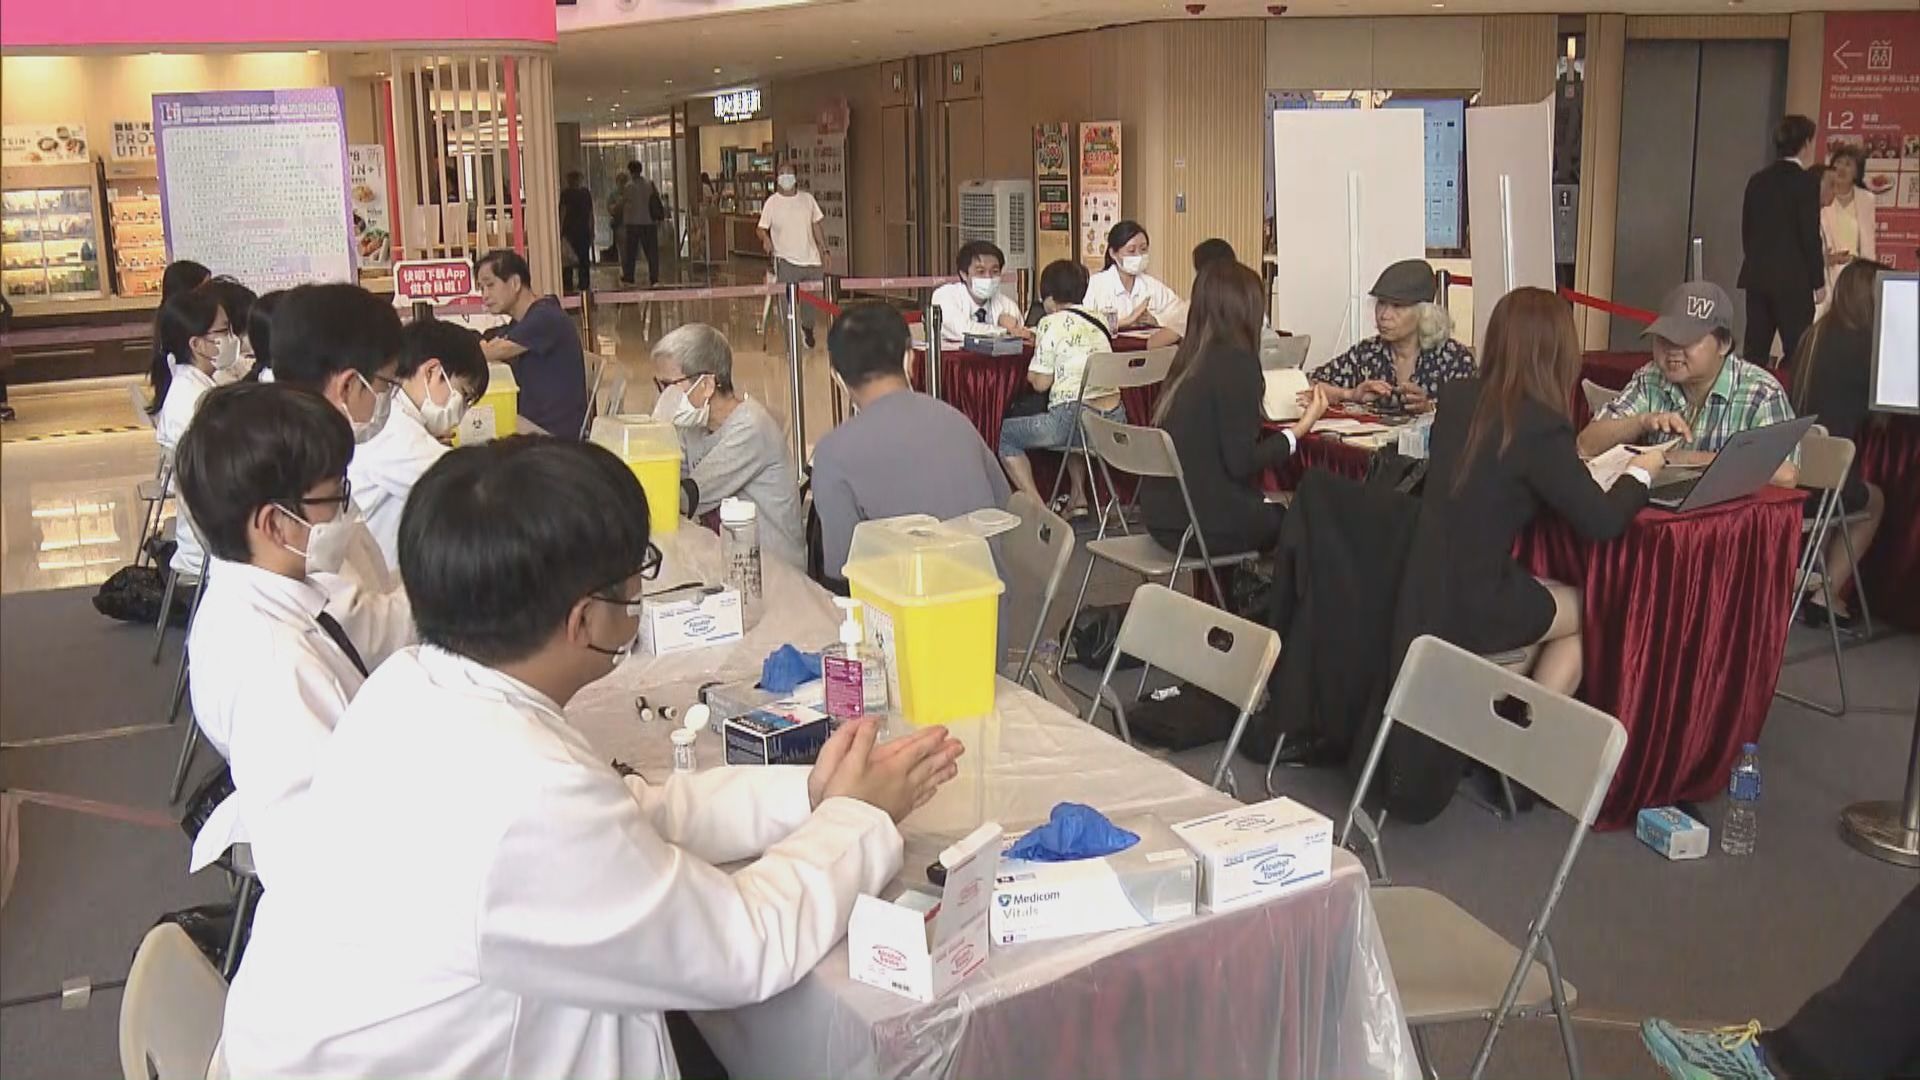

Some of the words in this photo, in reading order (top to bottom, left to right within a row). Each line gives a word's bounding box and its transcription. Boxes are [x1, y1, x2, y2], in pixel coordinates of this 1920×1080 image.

[1828, 111, 1854, 129] L2
[1687, 295, 1715, 319] W
[1260, 858, 1290, 873] Alcohol
[1013, 891, 1060, 905] Medicom
[1003, 905, 1039, 919] Vitals
